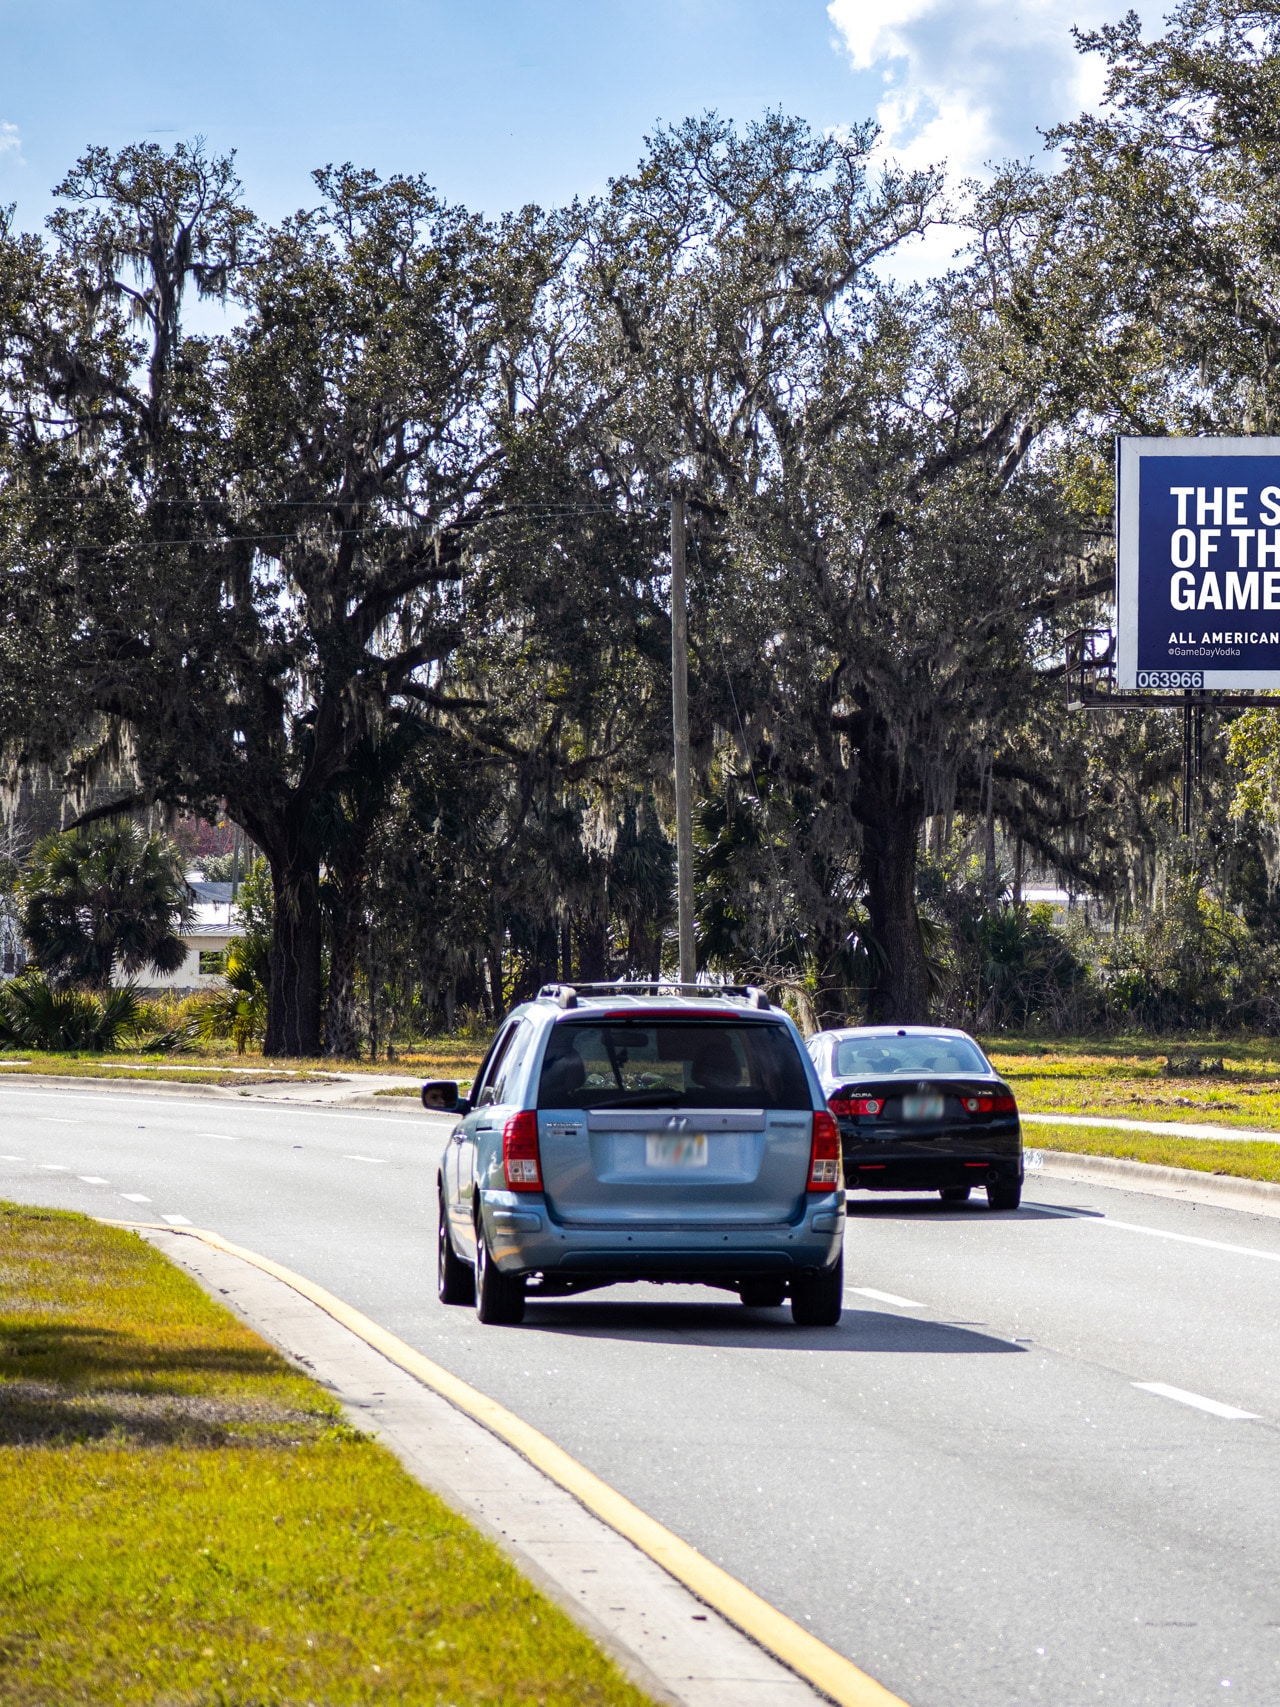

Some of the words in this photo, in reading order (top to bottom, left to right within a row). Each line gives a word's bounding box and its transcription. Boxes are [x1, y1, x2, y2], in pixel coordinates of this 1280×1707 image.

[1170, 487, 1248, 526] THE
[1170, 528, 1221, 568] OF
[1168, 632, 1196, 644] ALL
[1201, 632, 1279, 644] AMERICAN
[1168, 648, 1241, 657] @GameDayVodka
[1139, 672, 1202, 687] 063966
